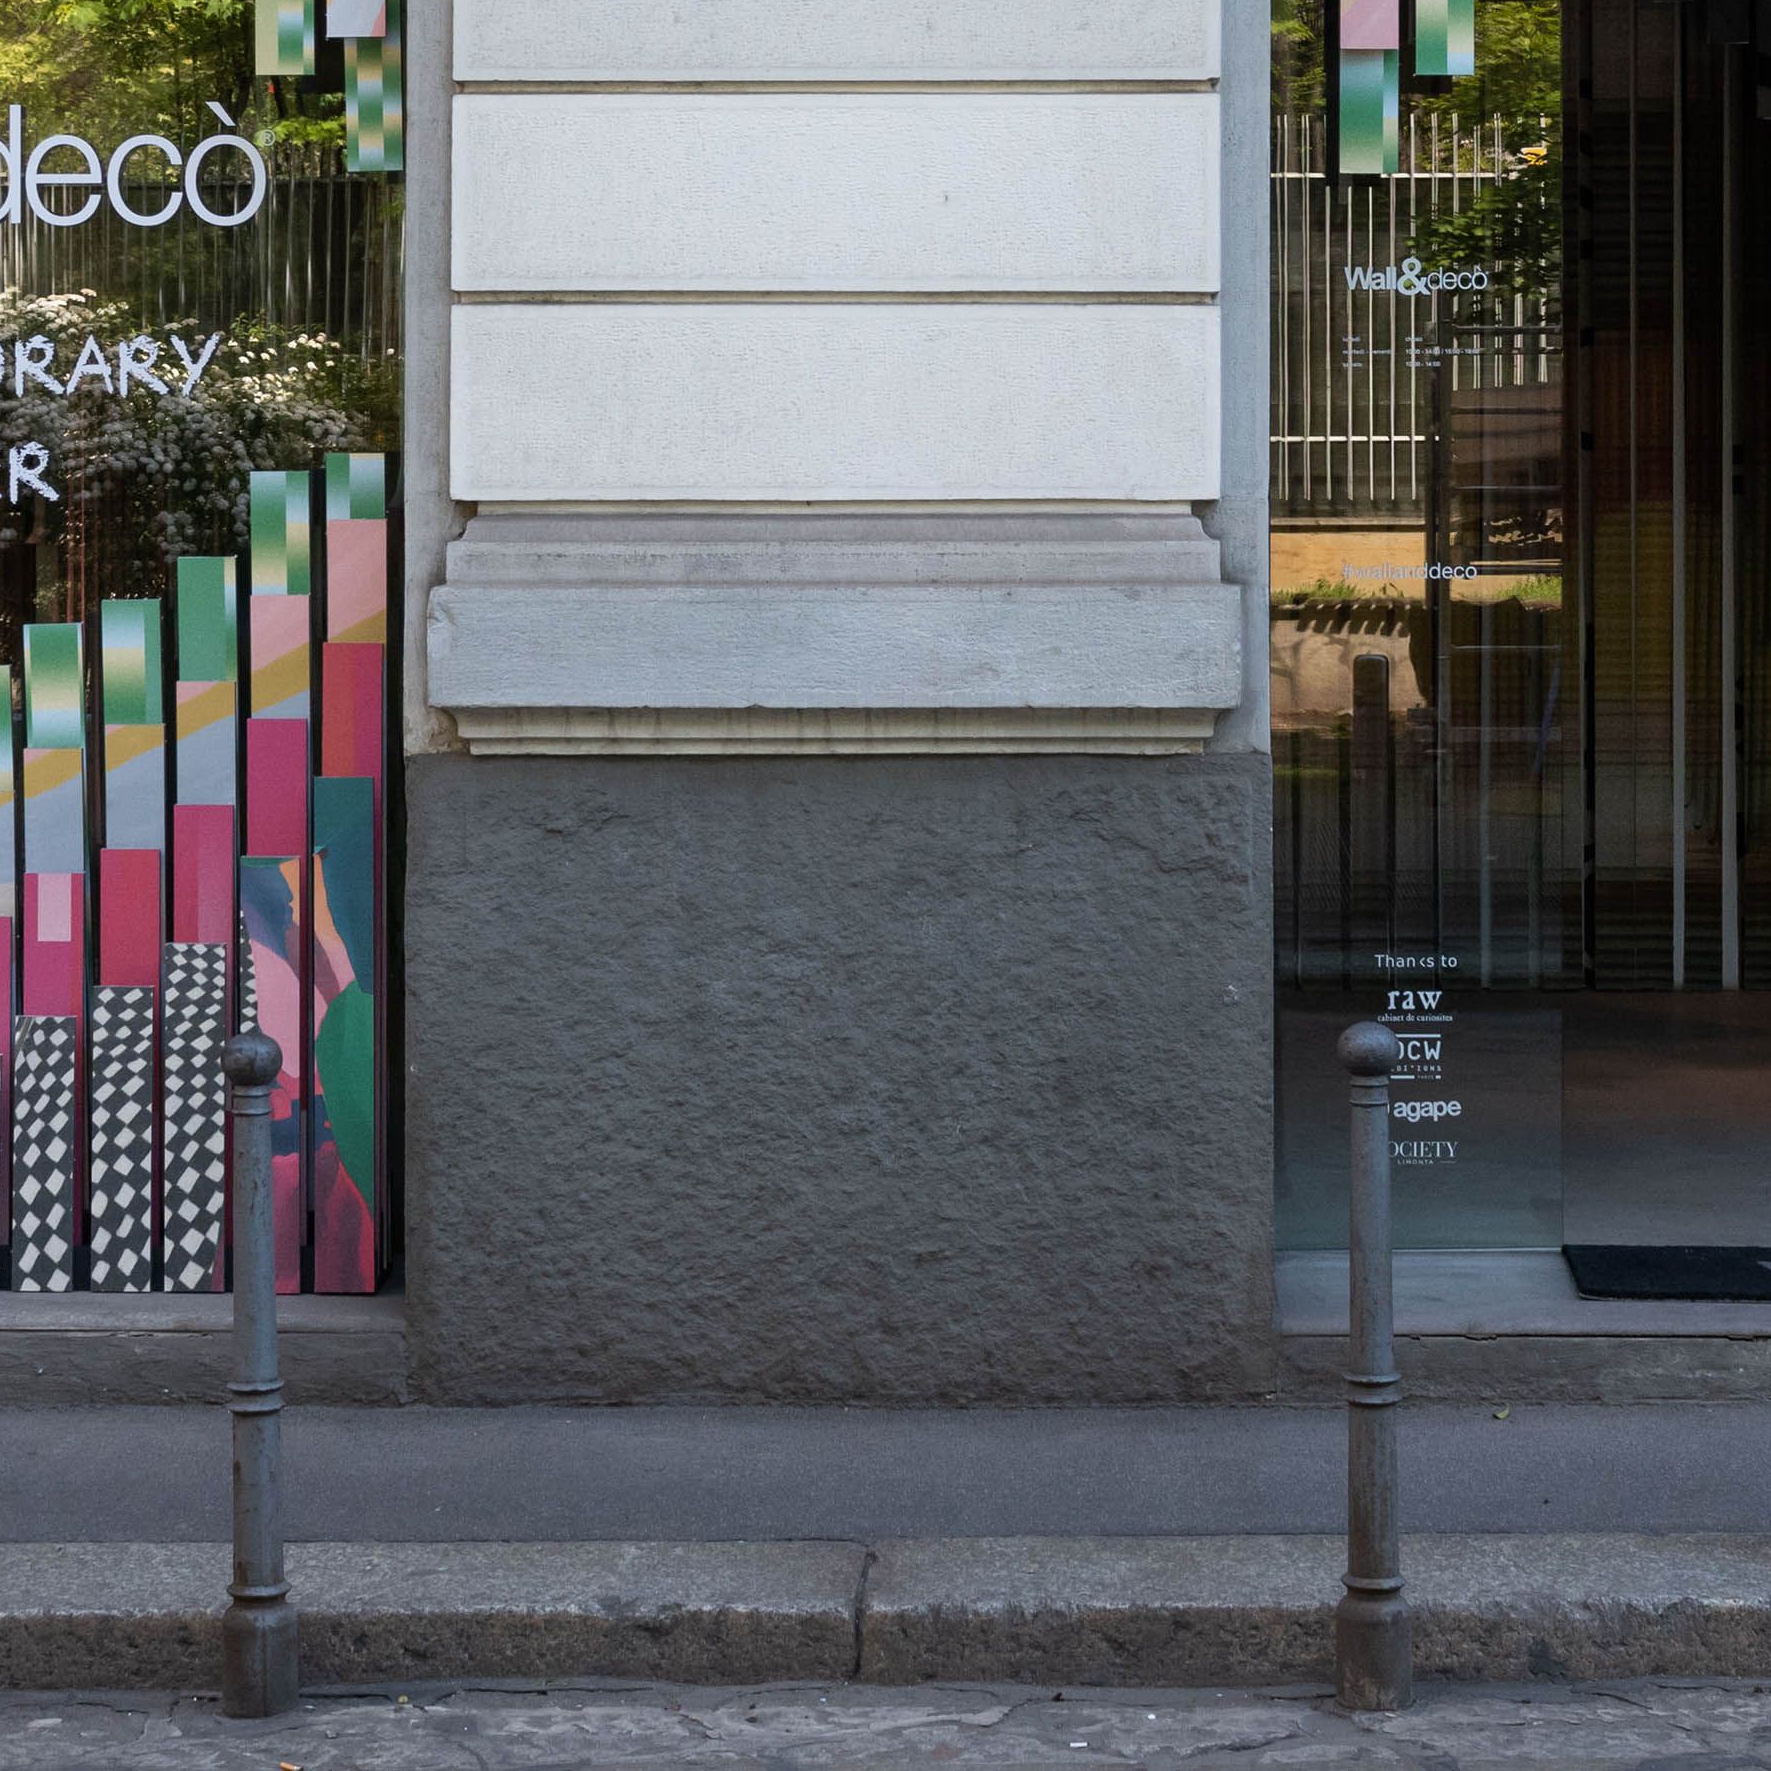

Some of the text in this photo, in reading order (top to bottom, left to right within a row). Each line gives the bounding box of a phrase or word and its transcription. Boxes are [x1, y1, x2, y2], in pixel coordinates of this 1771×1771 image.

[1441, 954, 1458, 968] to
[1387, 990, 1442, 1010] raw
[1393, 1100, 1462, 1122] agape
[1388, 1141, 1458, 1157] OCIETY
